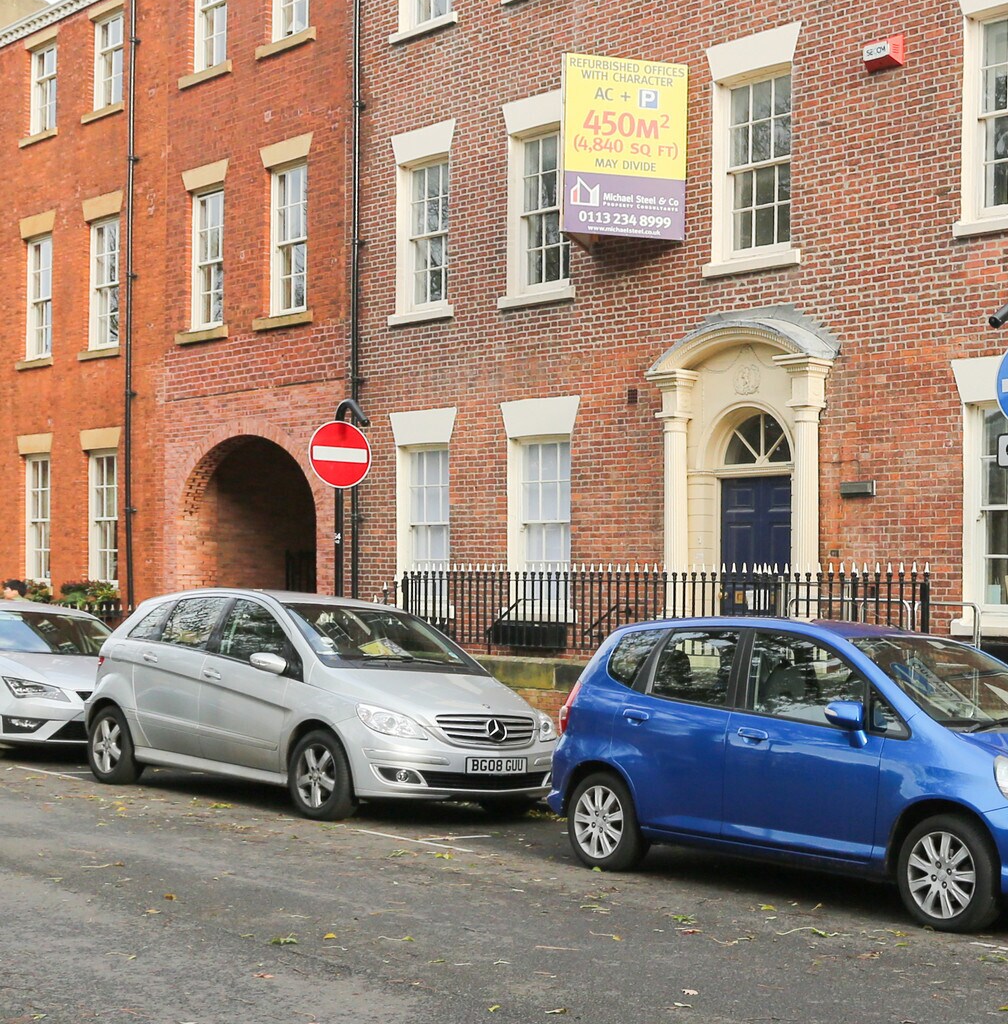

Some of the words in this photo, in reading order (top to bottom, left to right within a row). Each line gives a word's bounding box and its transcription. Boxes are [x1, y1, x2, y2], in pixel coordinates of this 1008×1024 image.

[569, 57, 640, 73] REFURBISHED
[644, 64, 685, 78] OFFICES
[581, 69, 608, 81] WITH
[613, 73, 673, 87] CHARACTER
[594, 87, 614, 101] AC
[620, 92, 631, 102] +
[641, 90, 656, 107] P
[573, 134, 624, 153] (4,840
[630, 142, 651, 157] SQ
[658, 142, 679, 160] FT)
[595, 158, 618, 168] MAY
[622, 160, 656, 172] DIVIDE
[603, 192, 633, 203] Michael
[636, 195, 656, 205] Steel
[658, 197, 667, 205] &
[668, 198, 679, 207] Co
[578, 210, 611, 224] 0113
[613, 213, 637, 226] 234
[639, 215, 672, 229] 8999
[471, 759, 503, 772] BG08
[505, 759, 524, 772] GUU
